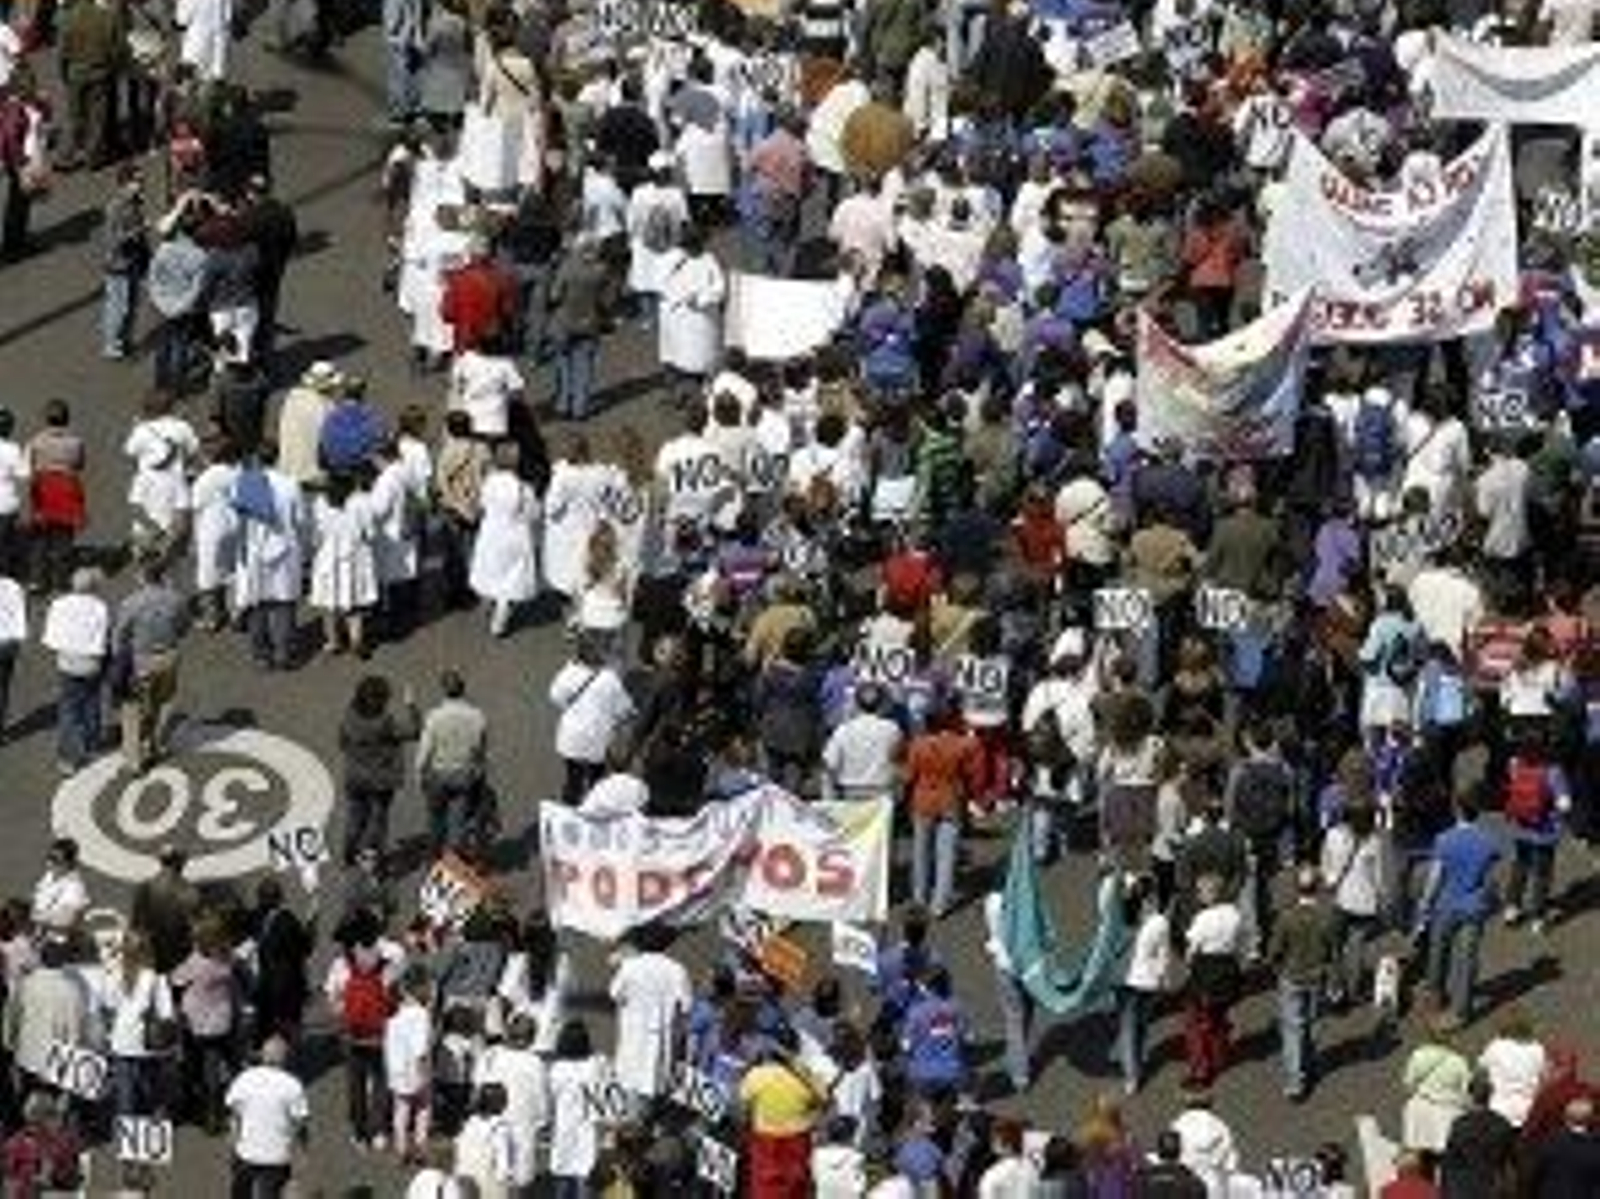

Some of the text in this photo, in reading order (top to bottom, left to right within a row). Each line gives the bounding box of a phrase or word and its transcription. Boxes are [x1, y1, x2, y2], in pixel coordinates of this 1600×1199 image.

[1252, 101, 1294, 130] NO
[674, 455, 720, 492] NO
[1096, 592, 1147, 625] NO
[1198, 589, 1246, 625] NO
[859, 645, 911, 680] NO
[957, 659, 1002, 693] NO
[116, 766, 270, 841] 30
[269, 828, 319, 861] NO
[50, 1044, 105, 1093] NO
[583, 1082, 627, 1119] NO
[118, 1120, 166, 1159] NO
[1268, 1160, 1318, 1191] NO
